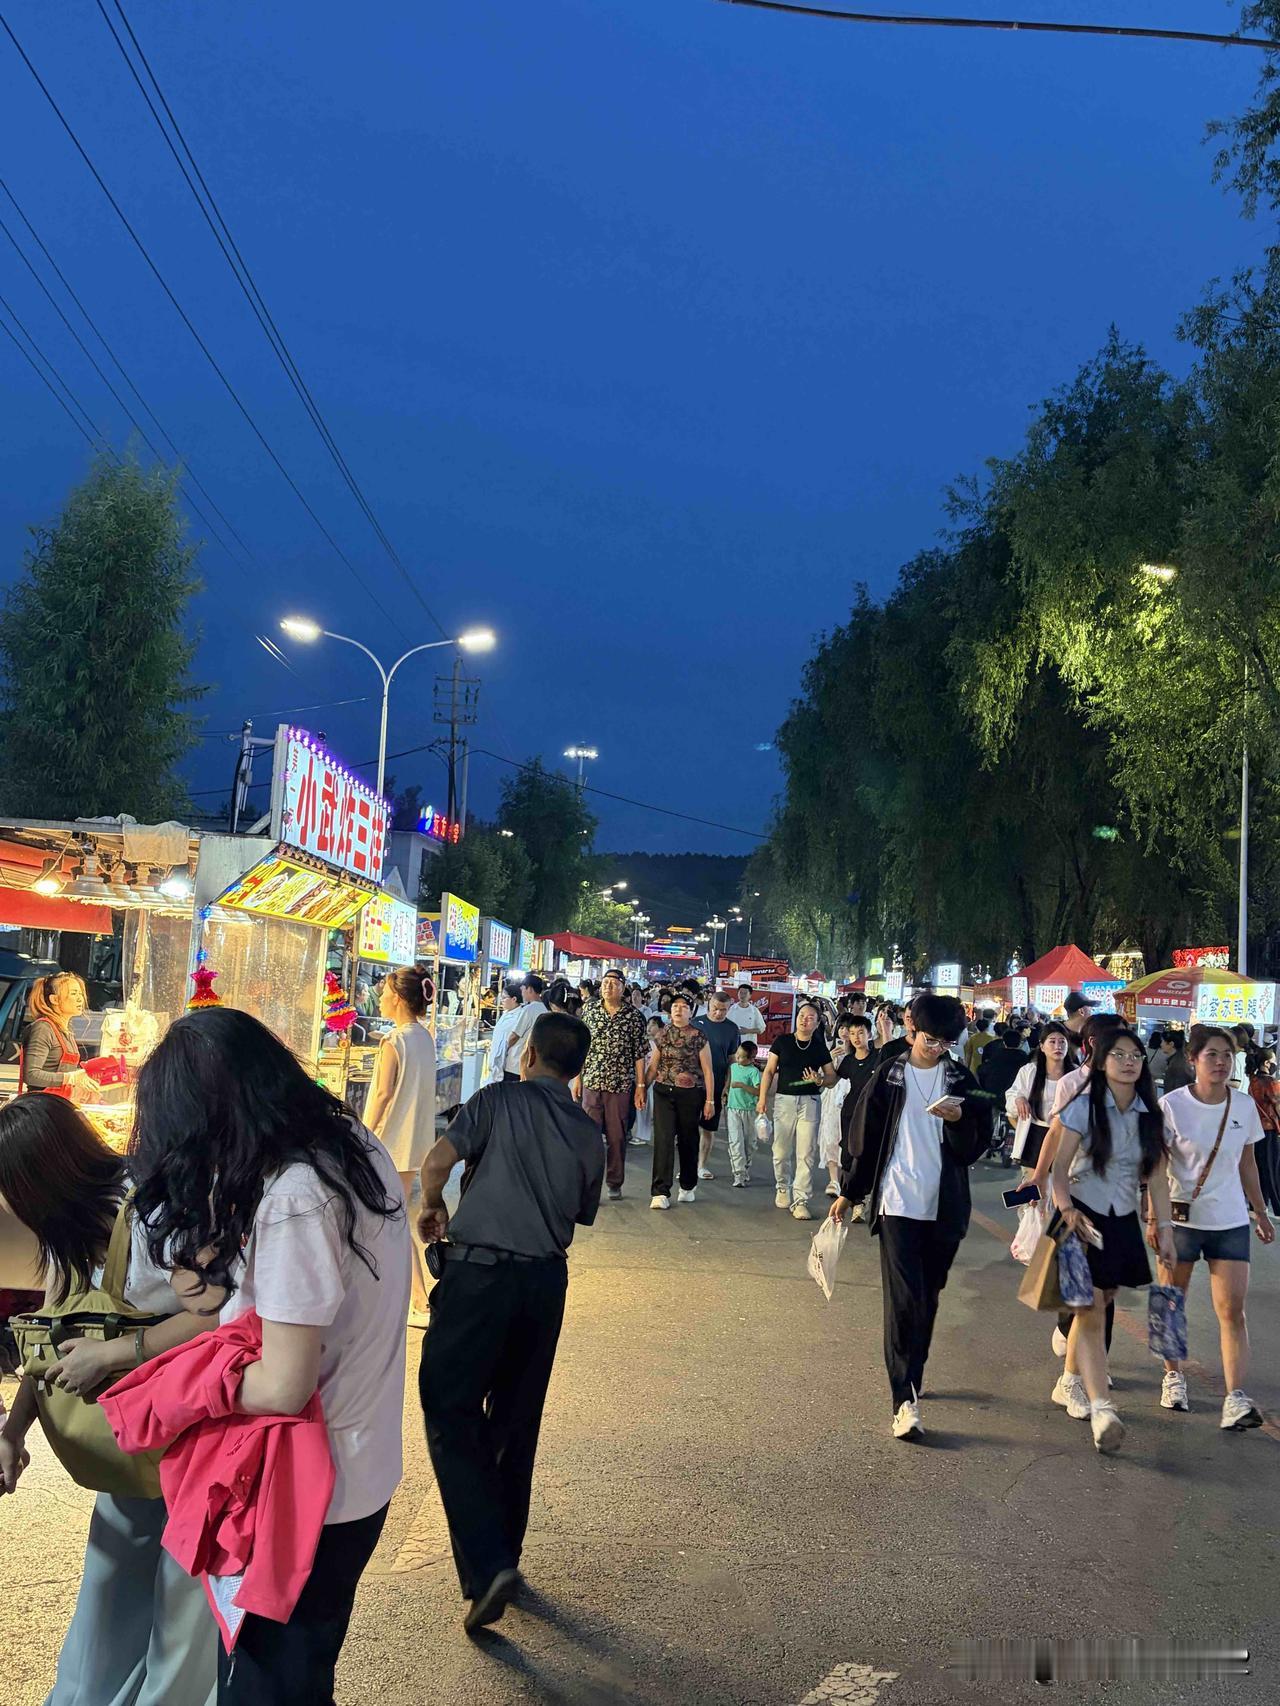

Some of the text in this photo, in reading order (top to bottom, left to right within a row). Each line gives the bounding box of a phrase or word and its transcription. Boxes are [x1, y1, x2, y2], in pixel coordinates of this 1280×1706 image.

[296, 755, 384, 881] 小武炸三样
